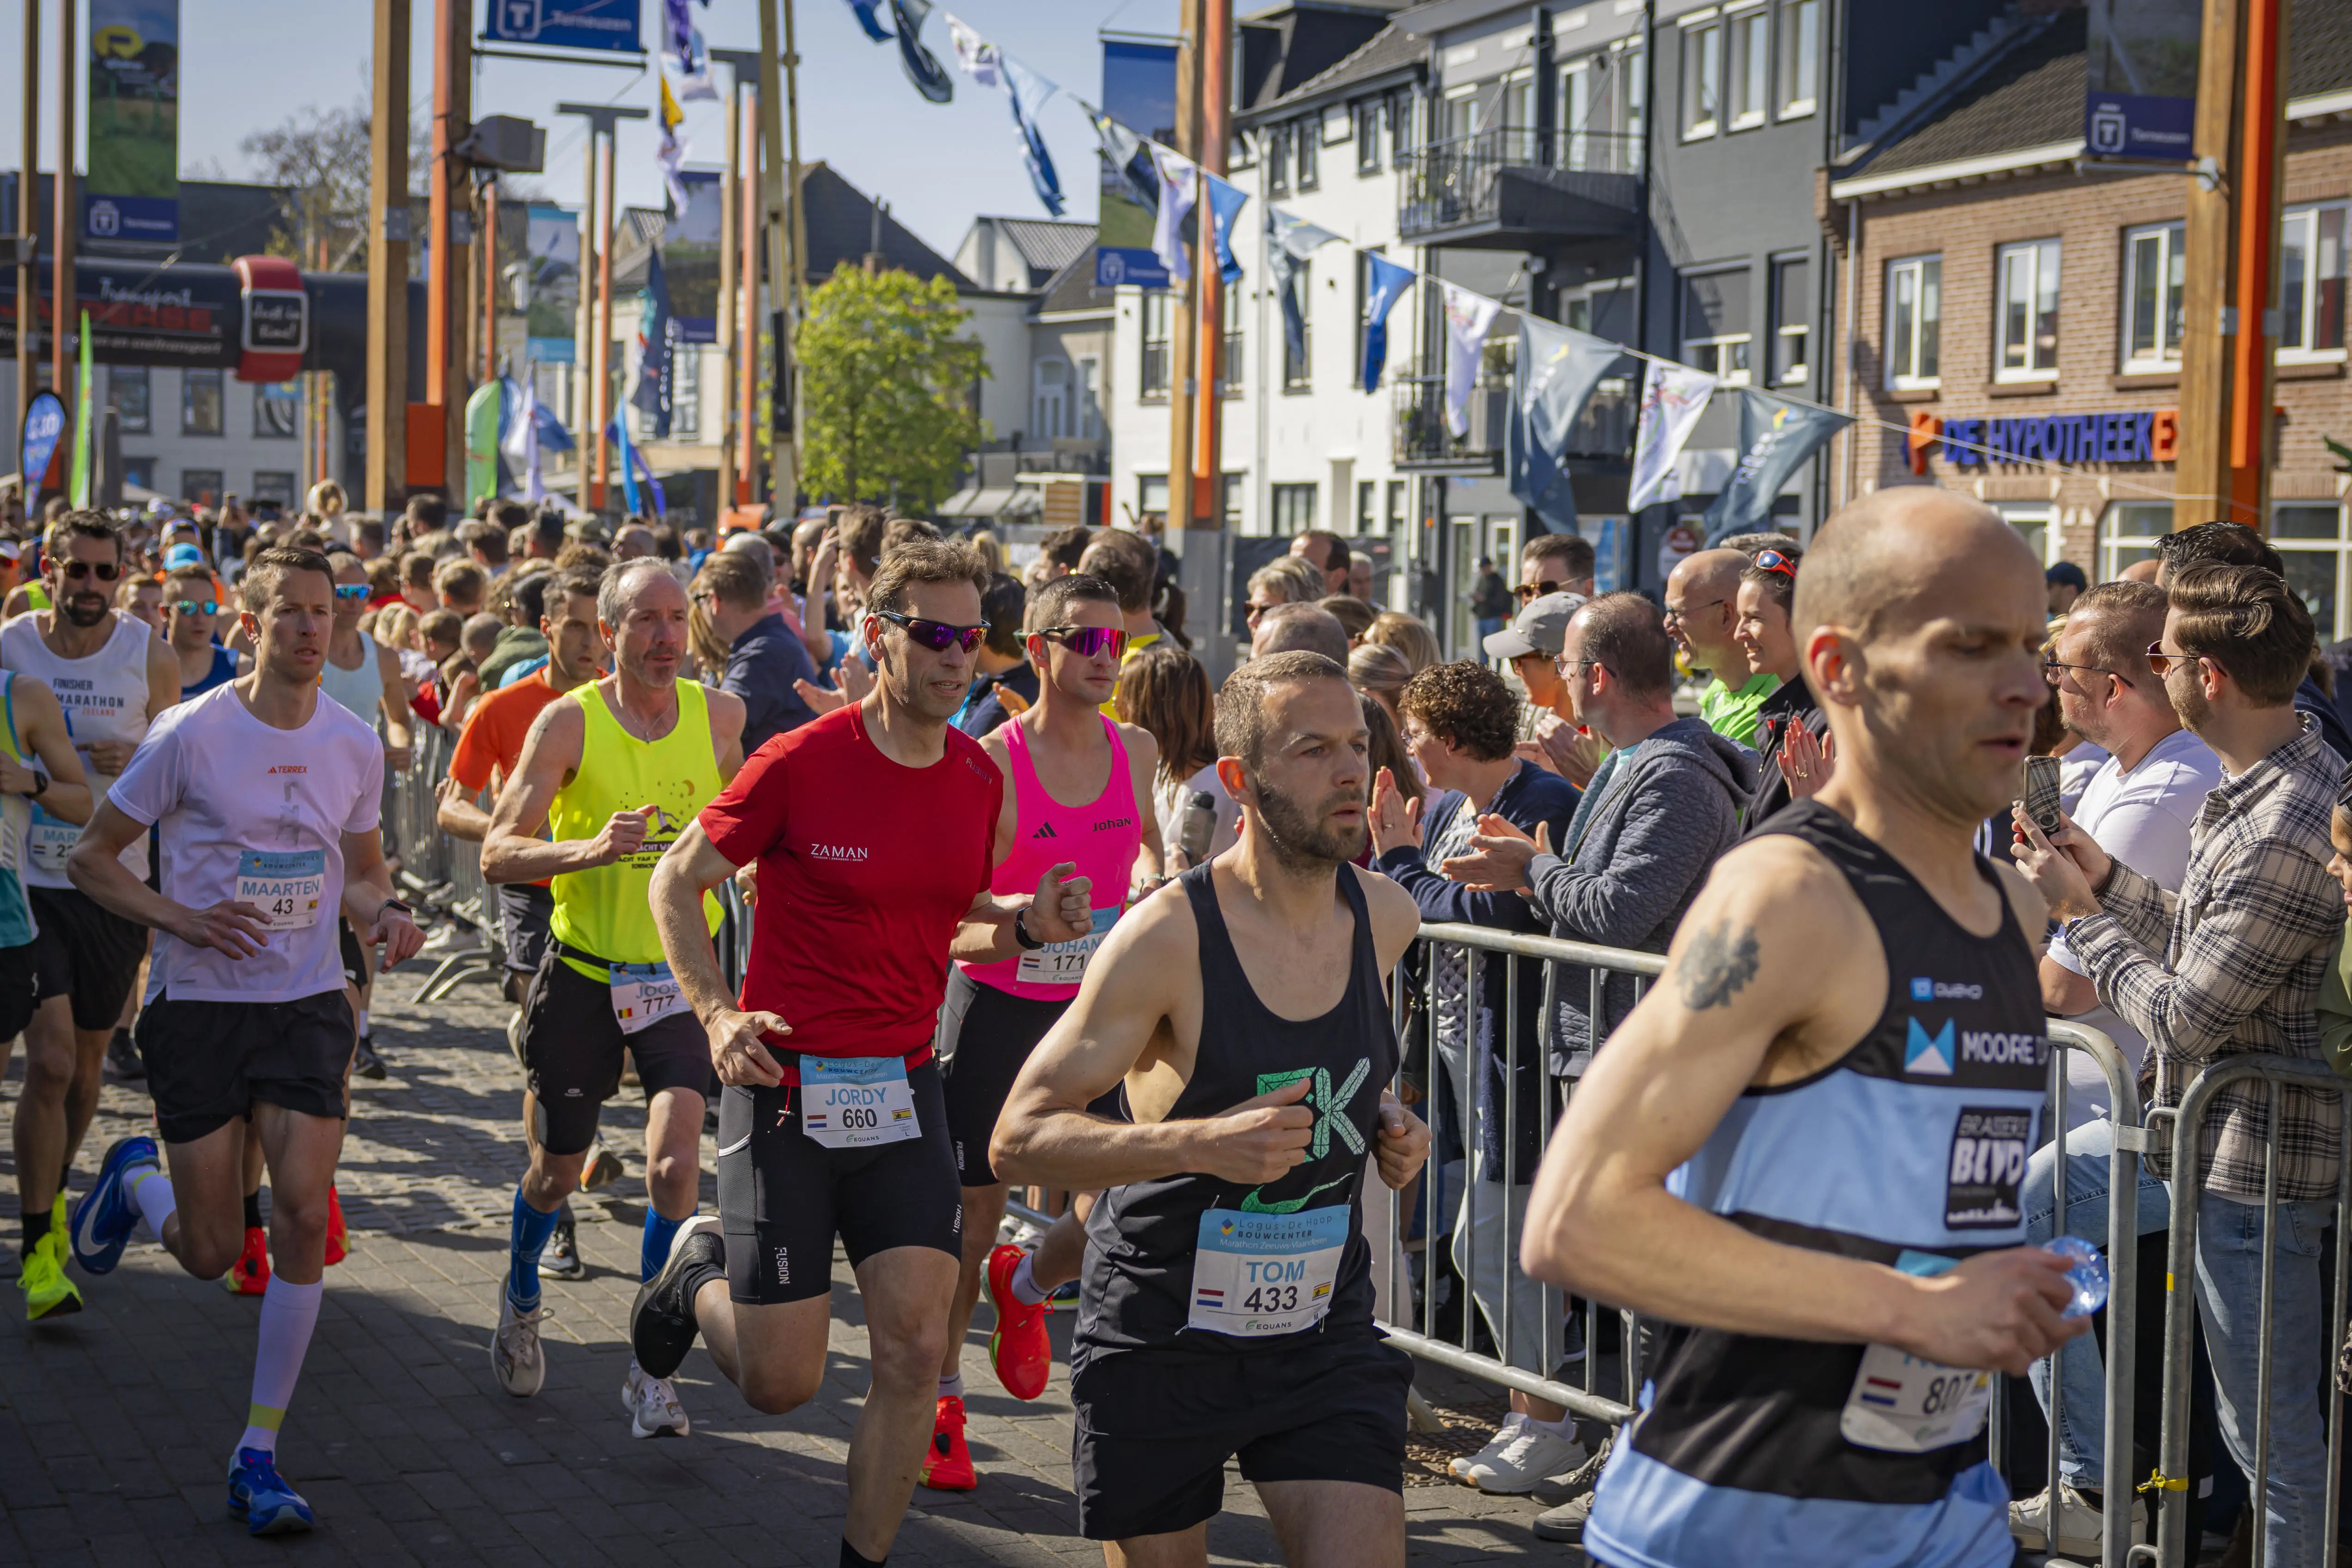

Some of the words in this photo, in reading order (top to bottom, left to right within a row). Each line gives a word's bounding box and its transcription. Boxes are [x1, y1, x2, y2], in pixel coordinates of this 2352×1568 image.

[1943, 417, 1980, 464] DE
[53, 677, 94, 691] FINISHER
[55, 693, 125, 709] MARATHON
[810, 844, 868, 858] ZAMAN
[241, 879, 319, 896] MAARTEN
[272, 899, 294, 915] 43
[1041, 937, 1102, 953] JOHAN
[1054, 954, 1085, 970] 171
[642, 995, 675, 1015] 777
[1961, 1031, 2034, 1064] MOORE
[825, 1087, 887, 1107] JORDY
[842, 1108, 878, 1129] 660
[956, 1141, 965, 1170] FUSION
[1950, 1137, 2026, 1187] BLVD
[1306, 1215, 1332, 1225] Hoop
[1219, 1238, 1259, 1249] Marathon
[1260, 1237, 1327, 1250] Zeeuws-Vlaanderen
[1238, 1230, 1313, 1240] BOUWCENTER
[774, 1247, 790, 1284] FUSION
[1246, 1260, 1305, 1283] TOM
[1243, 1285, 1298, 1313] 433
[1256, 1321, 1292, 1330] EQUANS
